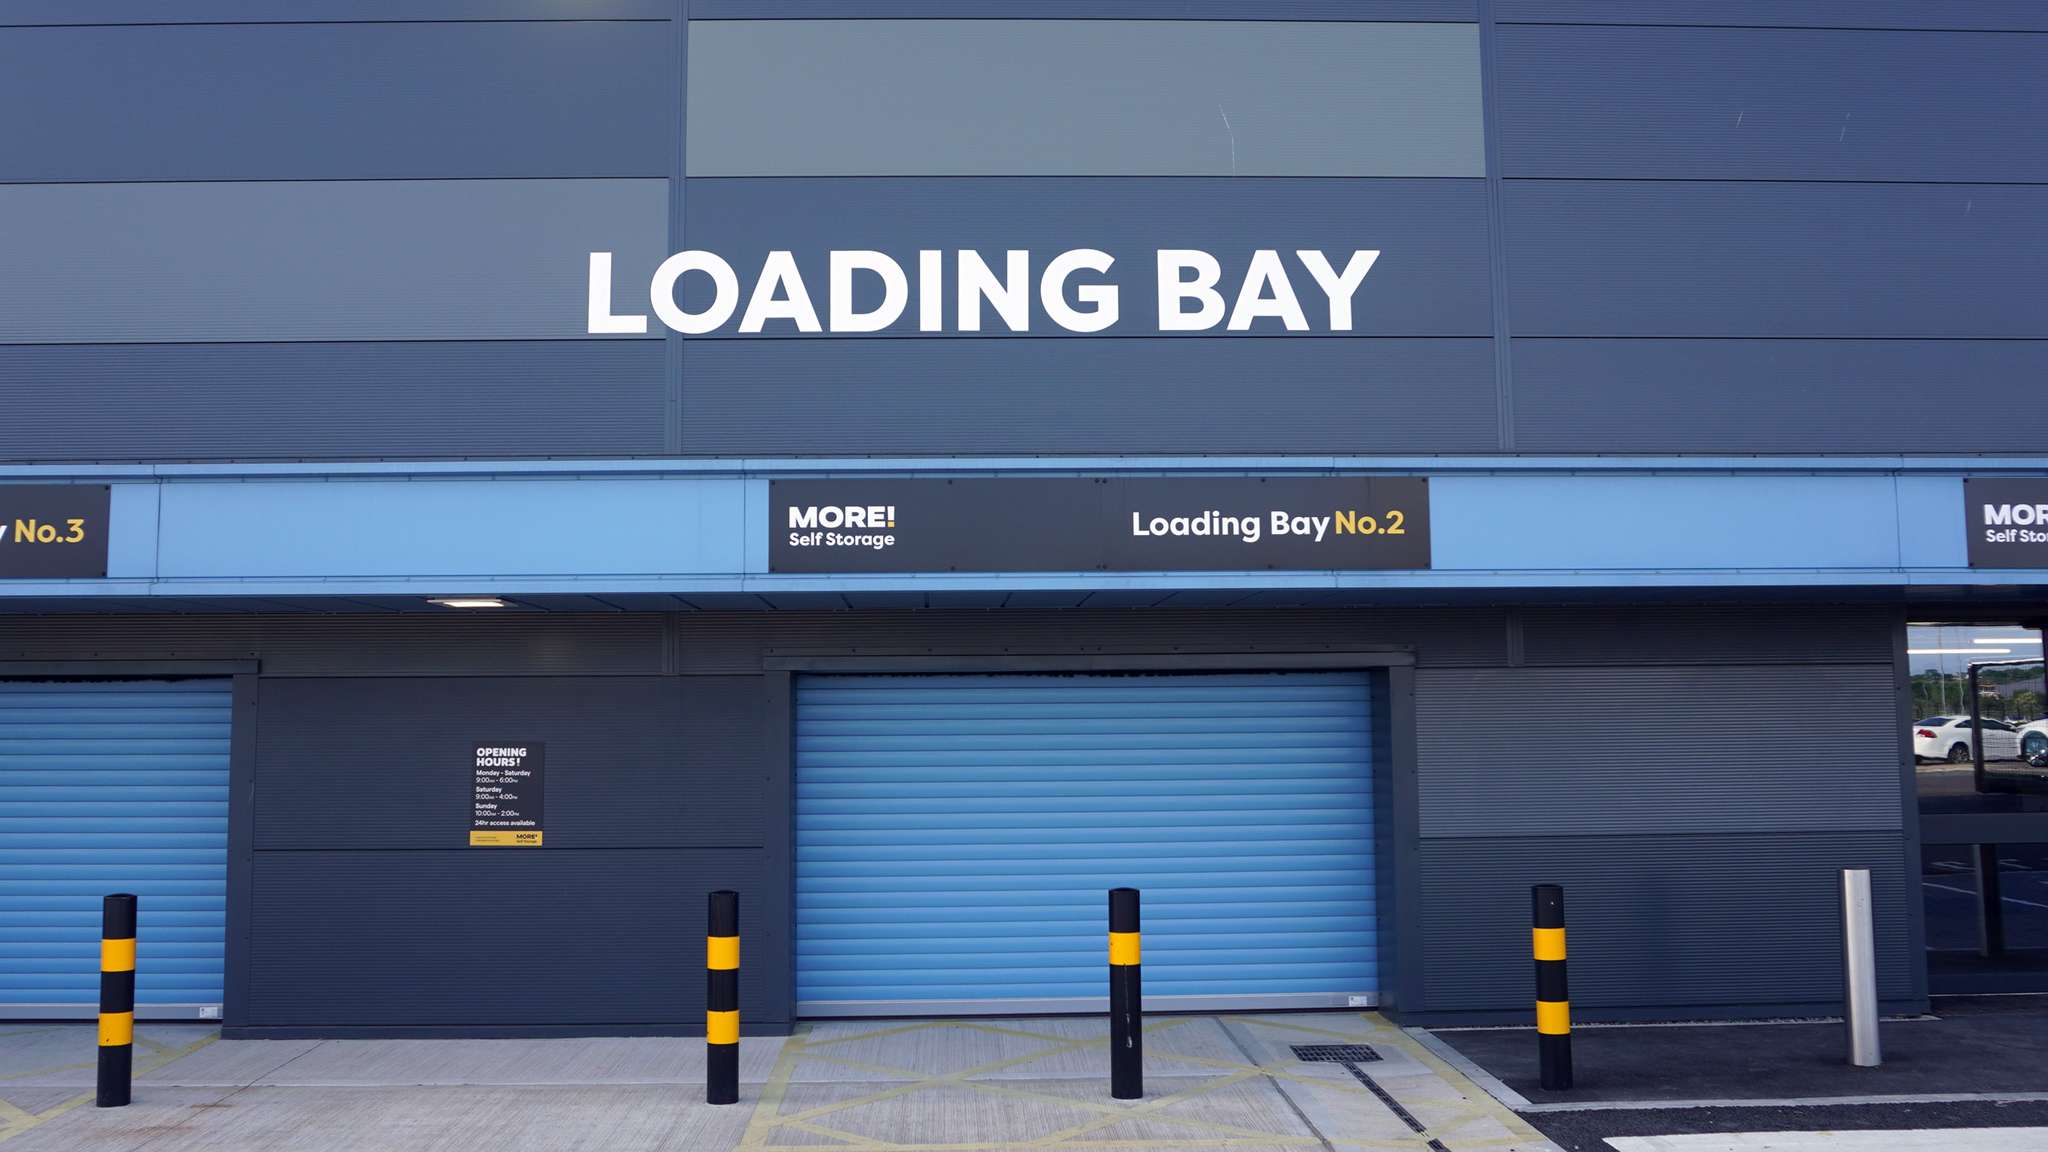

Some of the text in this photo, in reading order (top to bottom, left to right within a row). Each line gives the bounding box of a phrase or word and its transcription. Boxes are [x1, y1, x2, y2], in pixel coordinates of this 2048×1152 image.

[588, 249, 1380, 334] LOADING BAY
[788, 506, 895, 528] MORE!
[1132, 510, 1405, 543] Loading Bay No.2
[14, 517, 85, 543] No.3
[1986, 529, 2048, 543] Self Sto
[789, 532, 895, 550] Self Storage
[476, 748, 527, 757] OPENING
[476, 758, 520, 767] HOURS!
